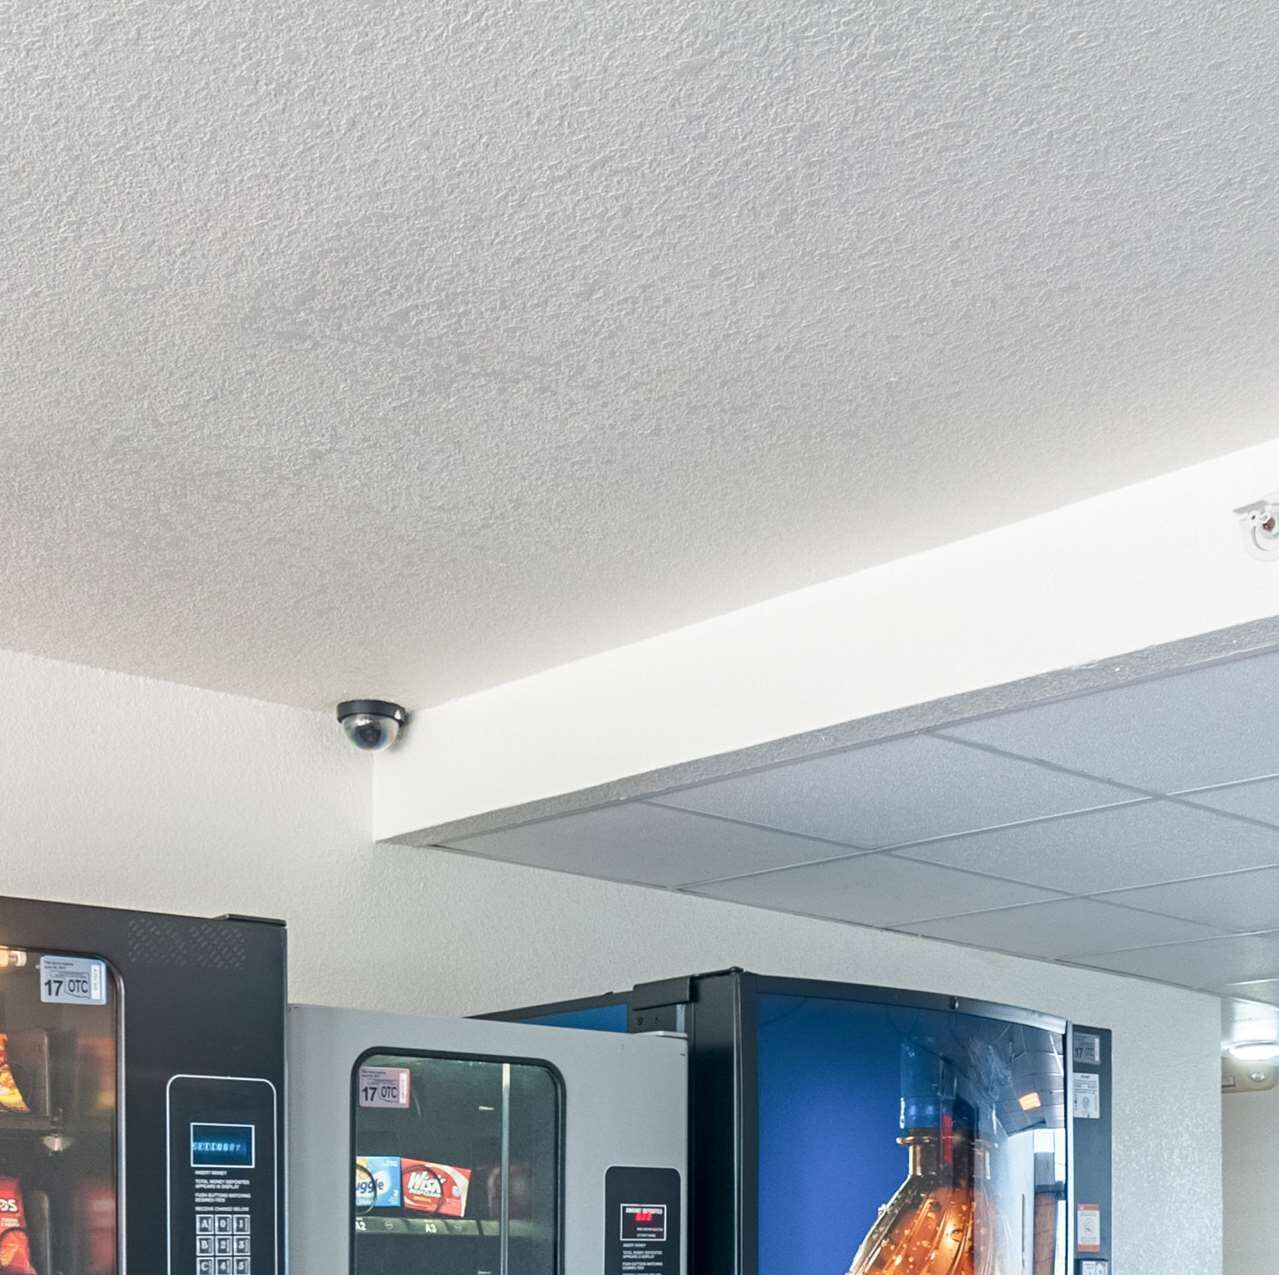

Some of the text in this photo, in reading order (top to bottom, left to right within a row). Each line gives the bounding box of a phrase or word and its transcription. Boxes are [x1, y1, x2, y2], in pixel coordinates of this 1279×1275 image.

[44, 979, 88, 996] 17 OTC
[361, 1085, 397, 1102] 17 OTC
